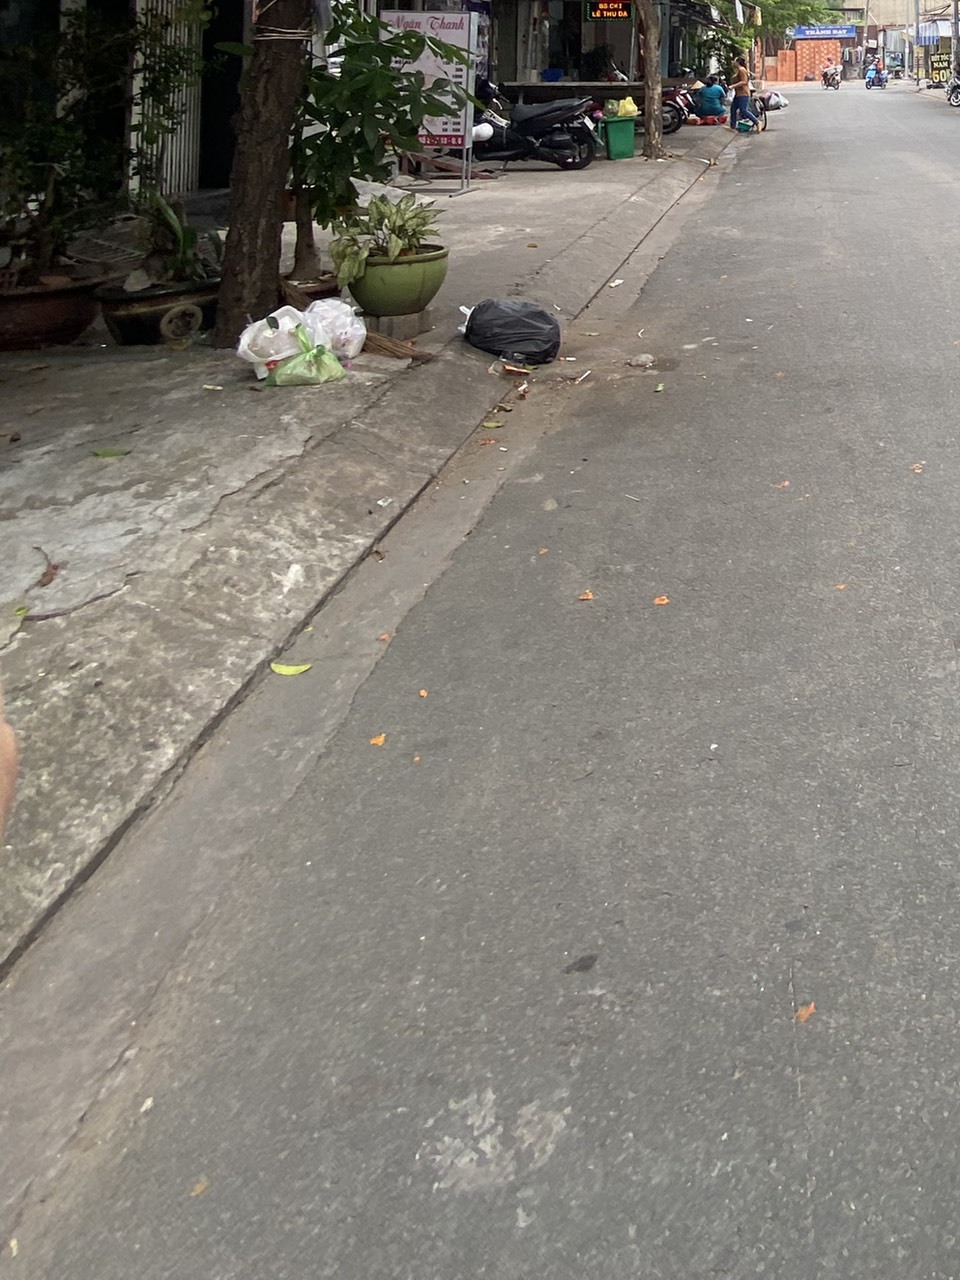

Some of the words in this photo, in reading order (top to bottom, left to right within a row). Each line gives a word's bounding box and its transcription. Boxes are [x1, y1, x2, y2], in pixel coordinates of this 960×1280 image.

[591, 10, 601, 18] LÊ
[426, 16, 465, 33] Thanh
[933, 61, 948, 69] NAM
